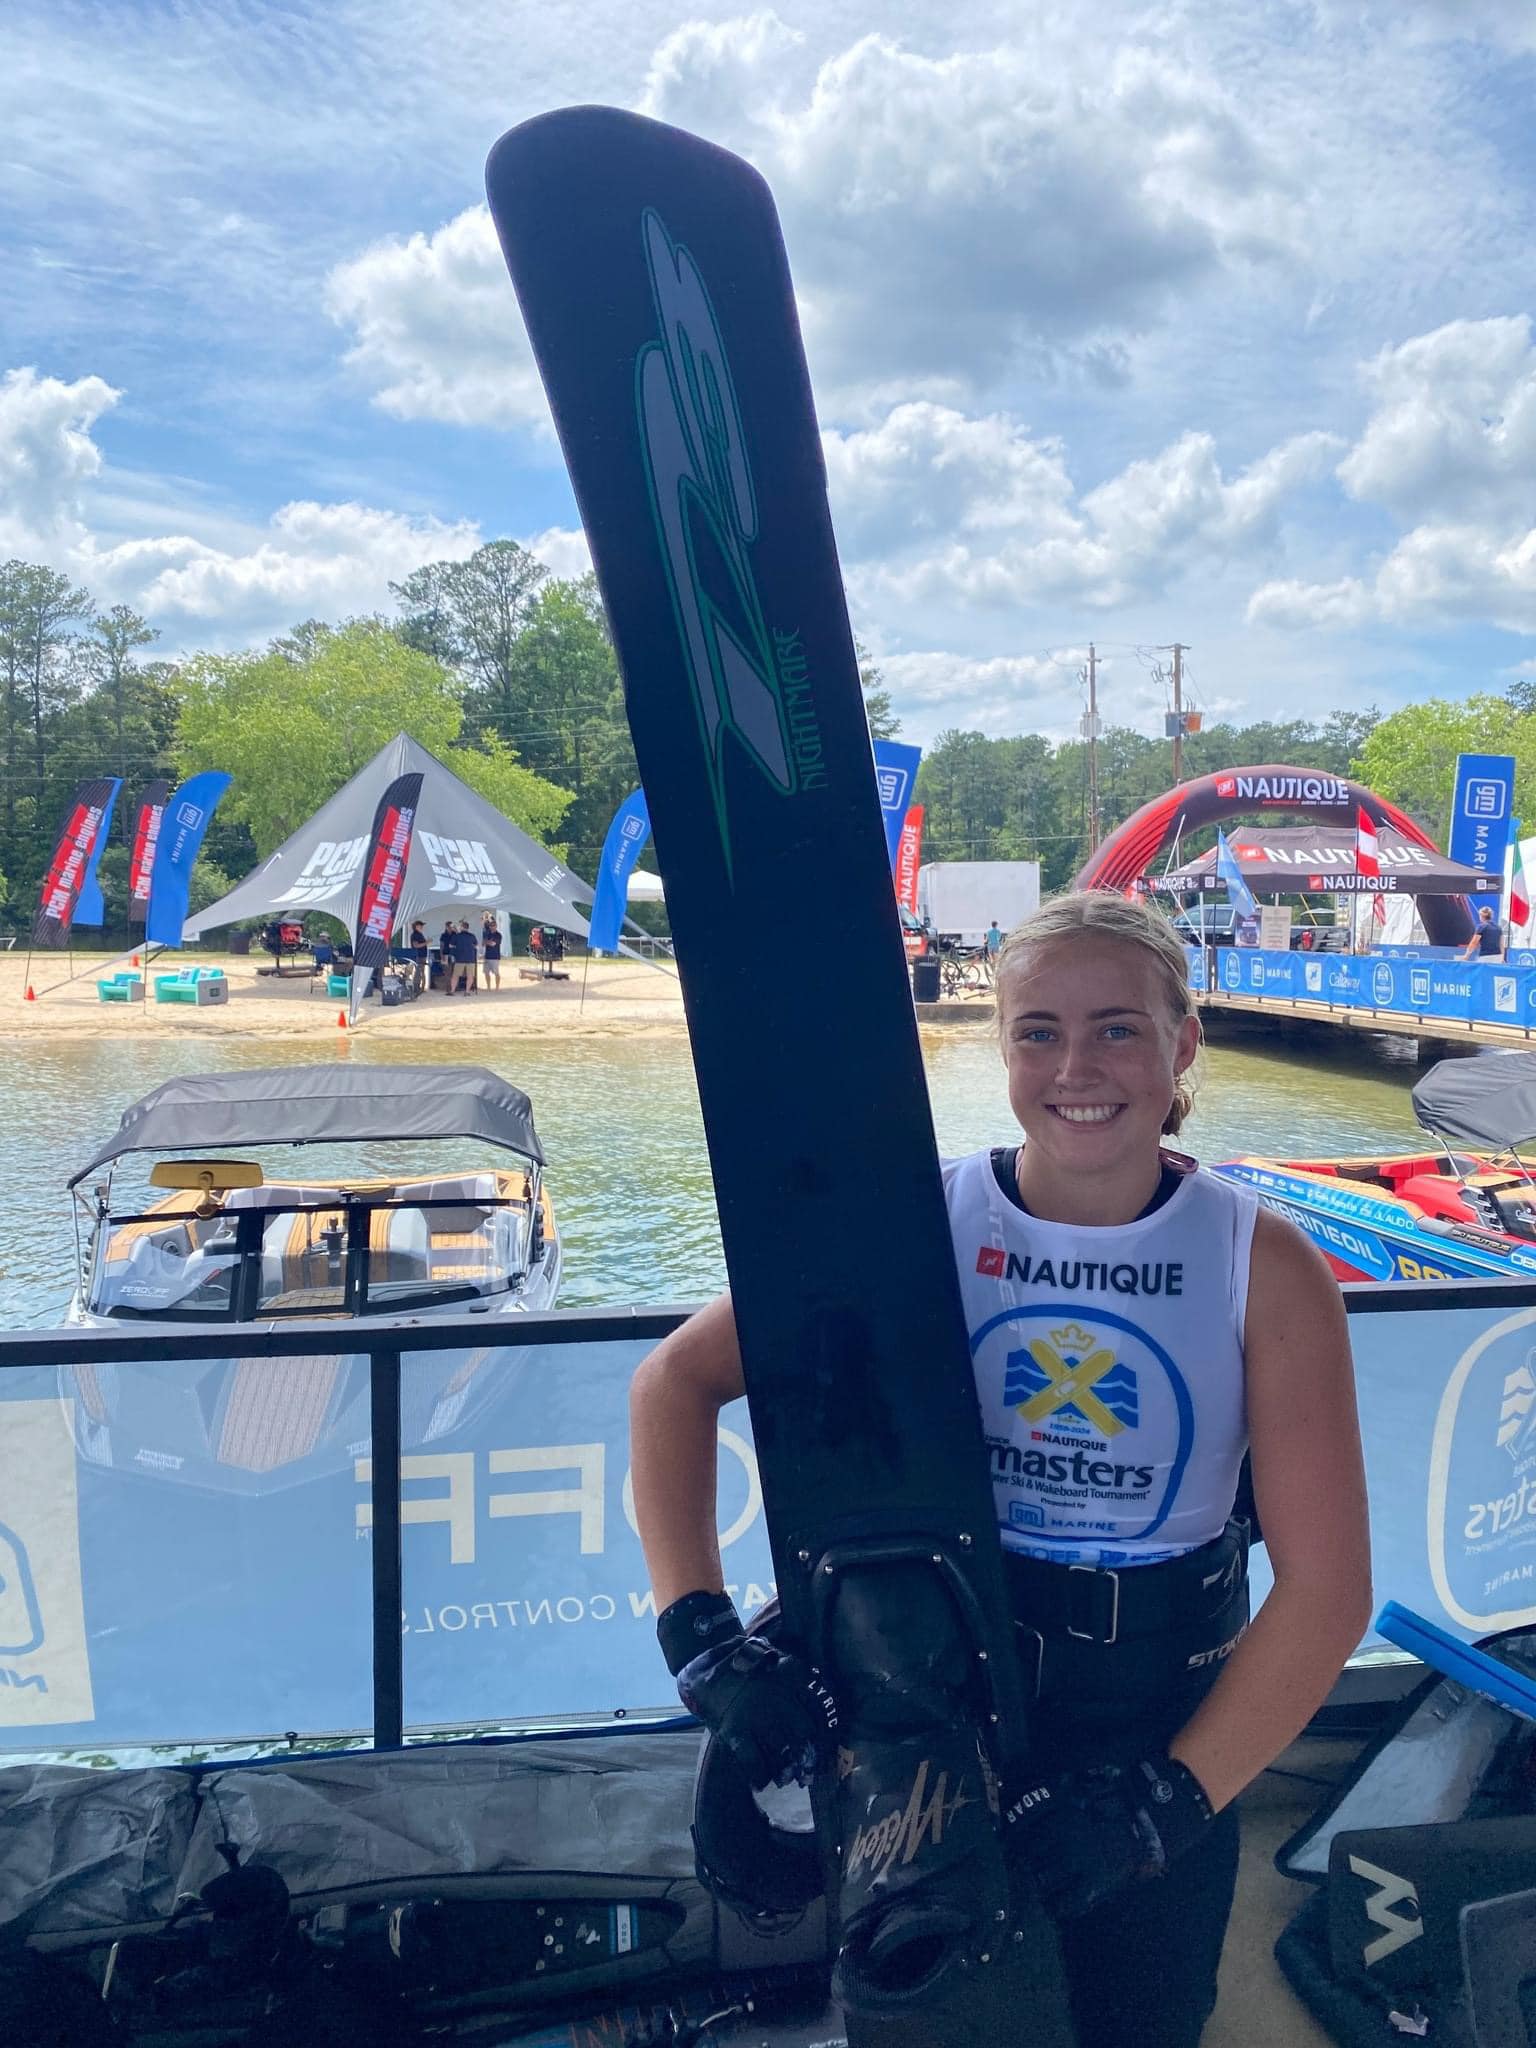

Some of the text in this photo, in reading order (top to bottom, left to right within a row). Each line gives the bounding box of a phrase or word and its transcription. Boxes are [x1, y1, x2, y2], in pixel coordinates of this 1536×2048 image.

[1237, 777, 1349, 800] NAUTIQUE
[46, 888, 71, 919] PCM
[75, 806, 102, 849] engines
[418, 830, 497, 874] PCM
[900, 824, 917, 899] NAUTIQUE
[1473, 825, 1488, 870] MARI
[364, 807, 413, 940] PCM marine engines
[1322, 876, 1397, 890] NAUTIQUE
[1433, 982, 1472, 998] MARINE
[1006, 1252, 1183, 1296] NAUTIQUE
[1042, 1433, 1107, 1452] NAUTIQUE
[1010, 1475, 1025, 1487] Ski
[1027, 1479, 1034, 1489] &
[1035, 1479, 1088, 1498] Wakeboard
[1051, 1519, 1117, 1532] MARINE
[807, 1681, 838, 1729] LYRIC
[1006, 1786, 1051, 1823] RADAR
